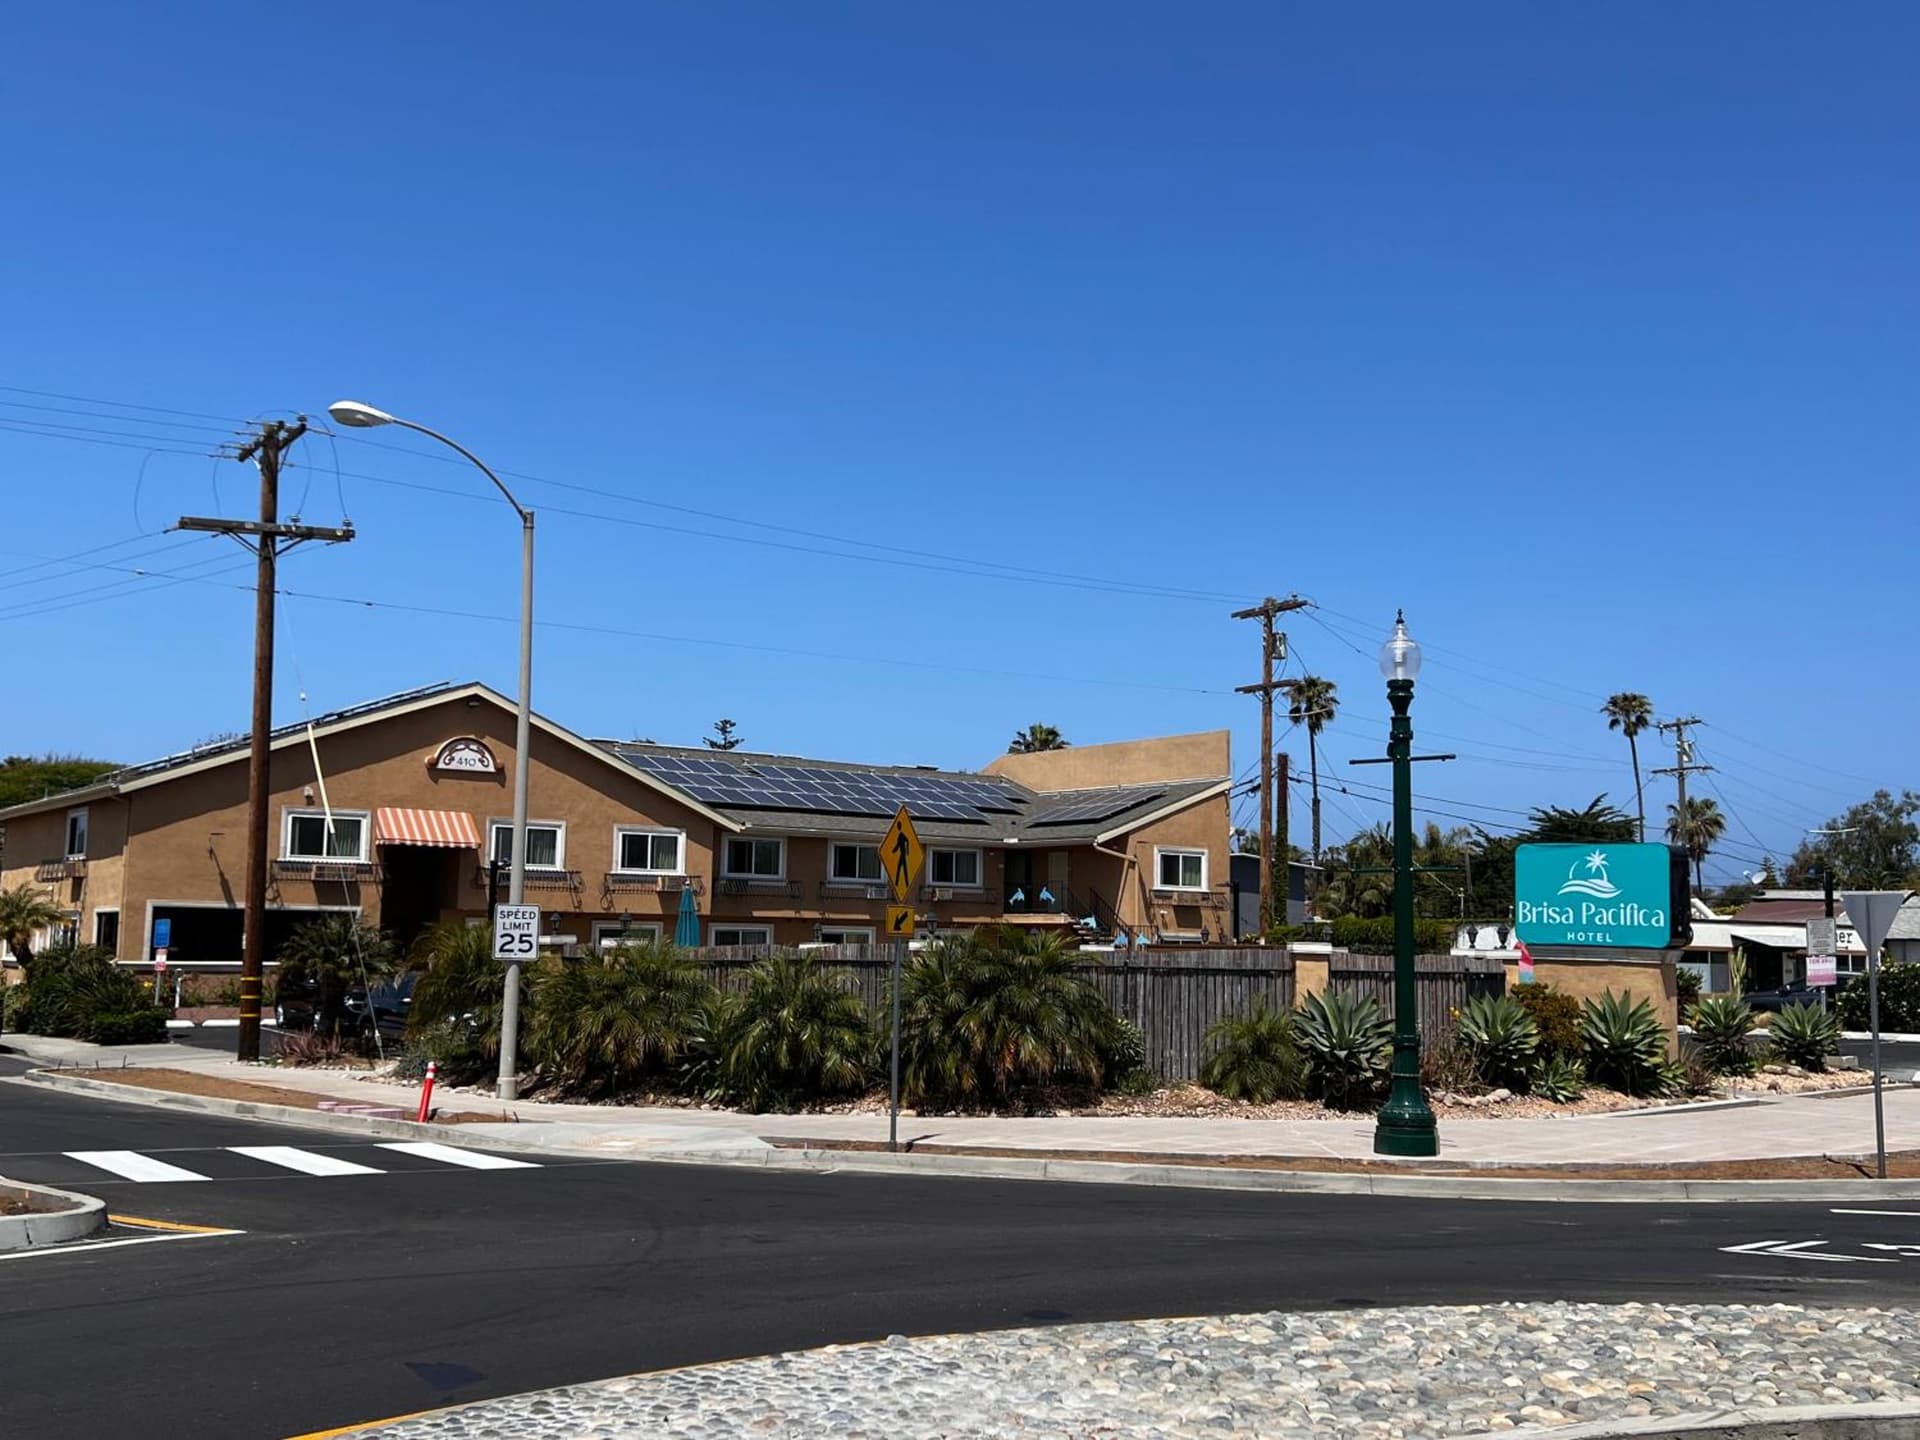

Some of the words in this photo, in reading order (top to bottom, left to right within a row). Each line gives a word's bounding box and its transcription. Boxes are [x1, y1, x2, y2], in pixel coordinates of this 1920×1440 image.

[456, 757, 477, 767] 410
[499, 910, 536, 920] SPEED
[1518, 900, 1574, 925] Brisa
[1582, 902, 1665, 927] Pacifica
[502, 921, 532, 931] LIMIT
[1567, 931, 1613, 943] HOTEL
[499, 933, 533, 953] 25
